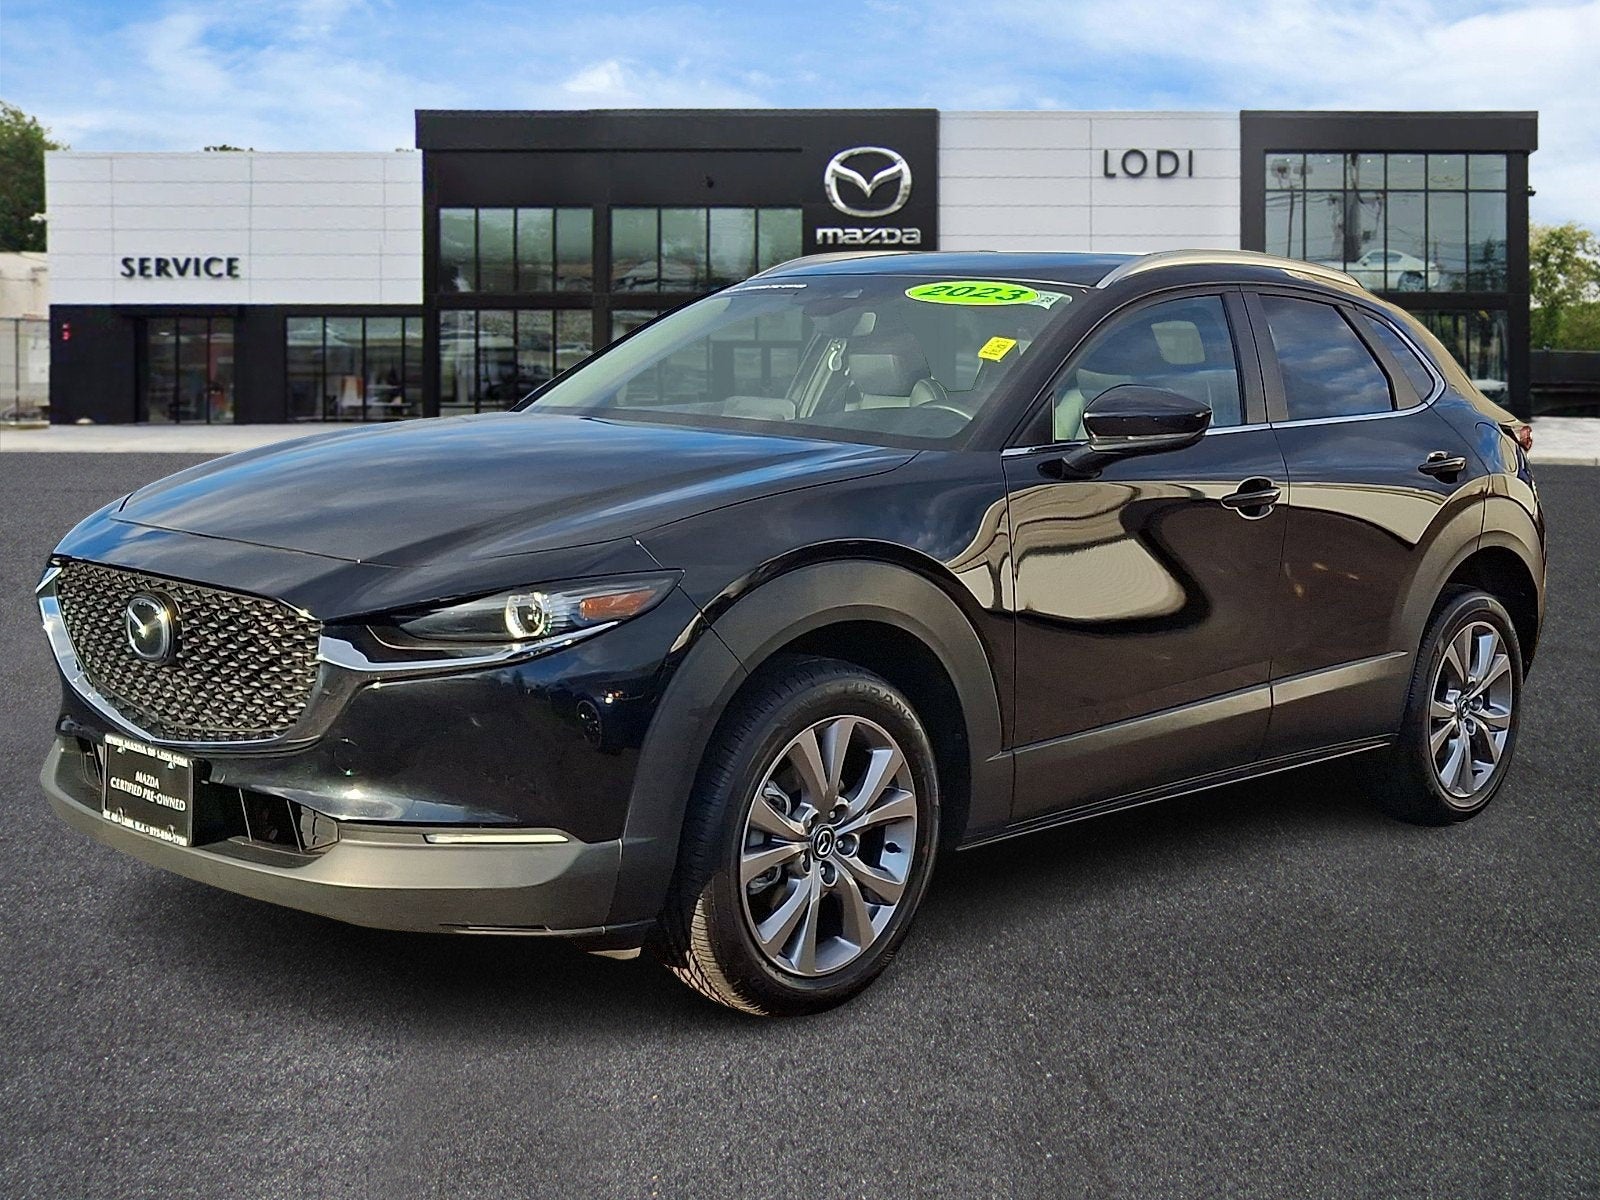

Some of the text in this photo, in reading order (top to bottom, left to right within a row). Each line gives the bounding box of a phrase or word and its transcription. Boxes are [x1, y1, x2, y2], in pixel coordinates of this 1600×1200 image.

[1103, 148, 1193, 179] LODI
[120, 256, 240, 278] SERVICE
[919, 285, 1029, 301] 2023
[135, 771, 160, 790] MAZDA
[110, 777, 186, 812] CERTIFIED PRE-OWNED
